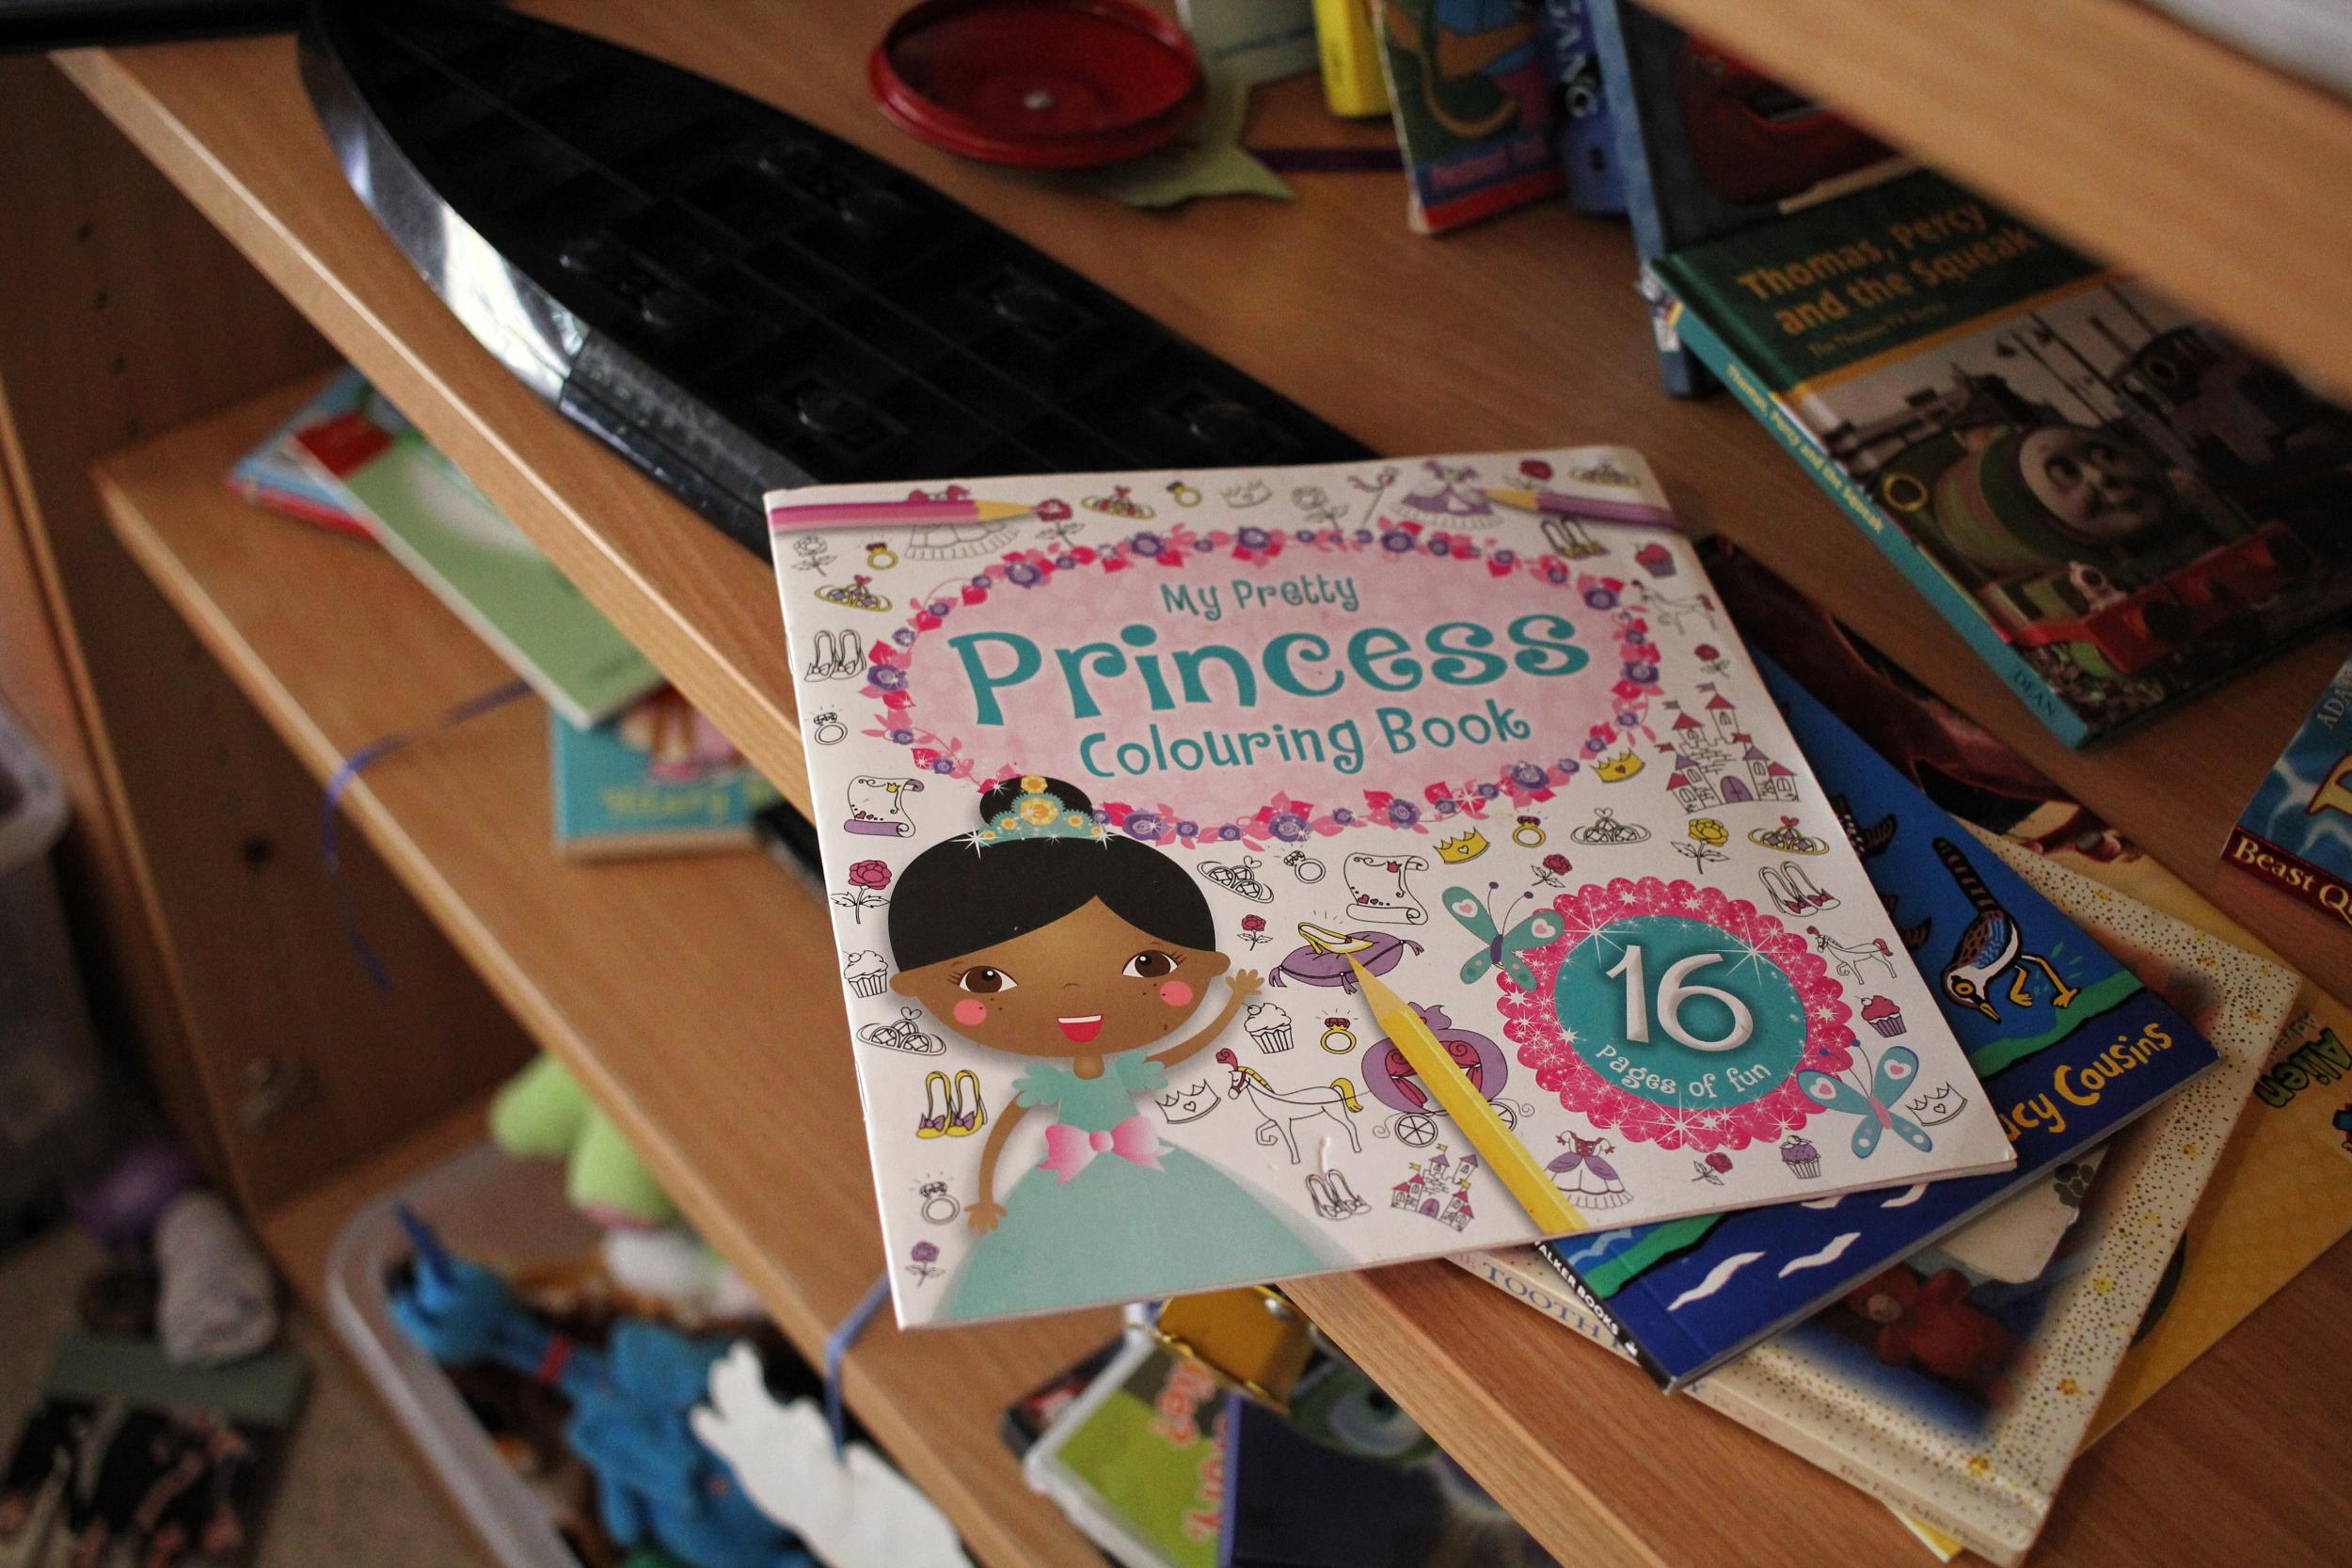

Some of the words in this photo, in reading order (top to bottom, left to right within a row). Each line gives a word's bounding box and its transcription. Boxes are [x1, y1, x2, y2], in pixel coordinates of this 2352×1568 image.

[1736, 238, 1898, 301] Thomas,
[1888, 204, 1989, 250] Percy
[1775, 288, 1850, 336] and
[1845, 271, 1915, 309] the
[1910, 226, 2040, 286] Squeak
[1160, 582, 1222, 622] My
[1232, 572, 1359, 612] Pretty
[946, 612, 1591, 727] Princess
[2013, 669, 2057, 717] DEAN
[1079, 718, 1365, 778] Colouring
[1375, 698, 1532, 756] Book
[2232, 835, 2315, 892] Beast
[2318, 884, 2352, 927] Q
[1605, 943, 1755, 1052] 16
[1595, 1043, 1677, 1095] Pages
[1689, 1072, 1718, 1100] of
[1725, 1063, 1772, 1093] fun
[1999, 1092, 2066, 1142] ucy
[2054, 1022, 2172, 1107] Cousins
[2253, 1026, 2352, 1109] Alien
[1483, 1260, 1600, 1339] TOOTH
[1534, 1241, 1576, 1289] ALKER
[1577, 1284, 1619, 1336] BOOKS
